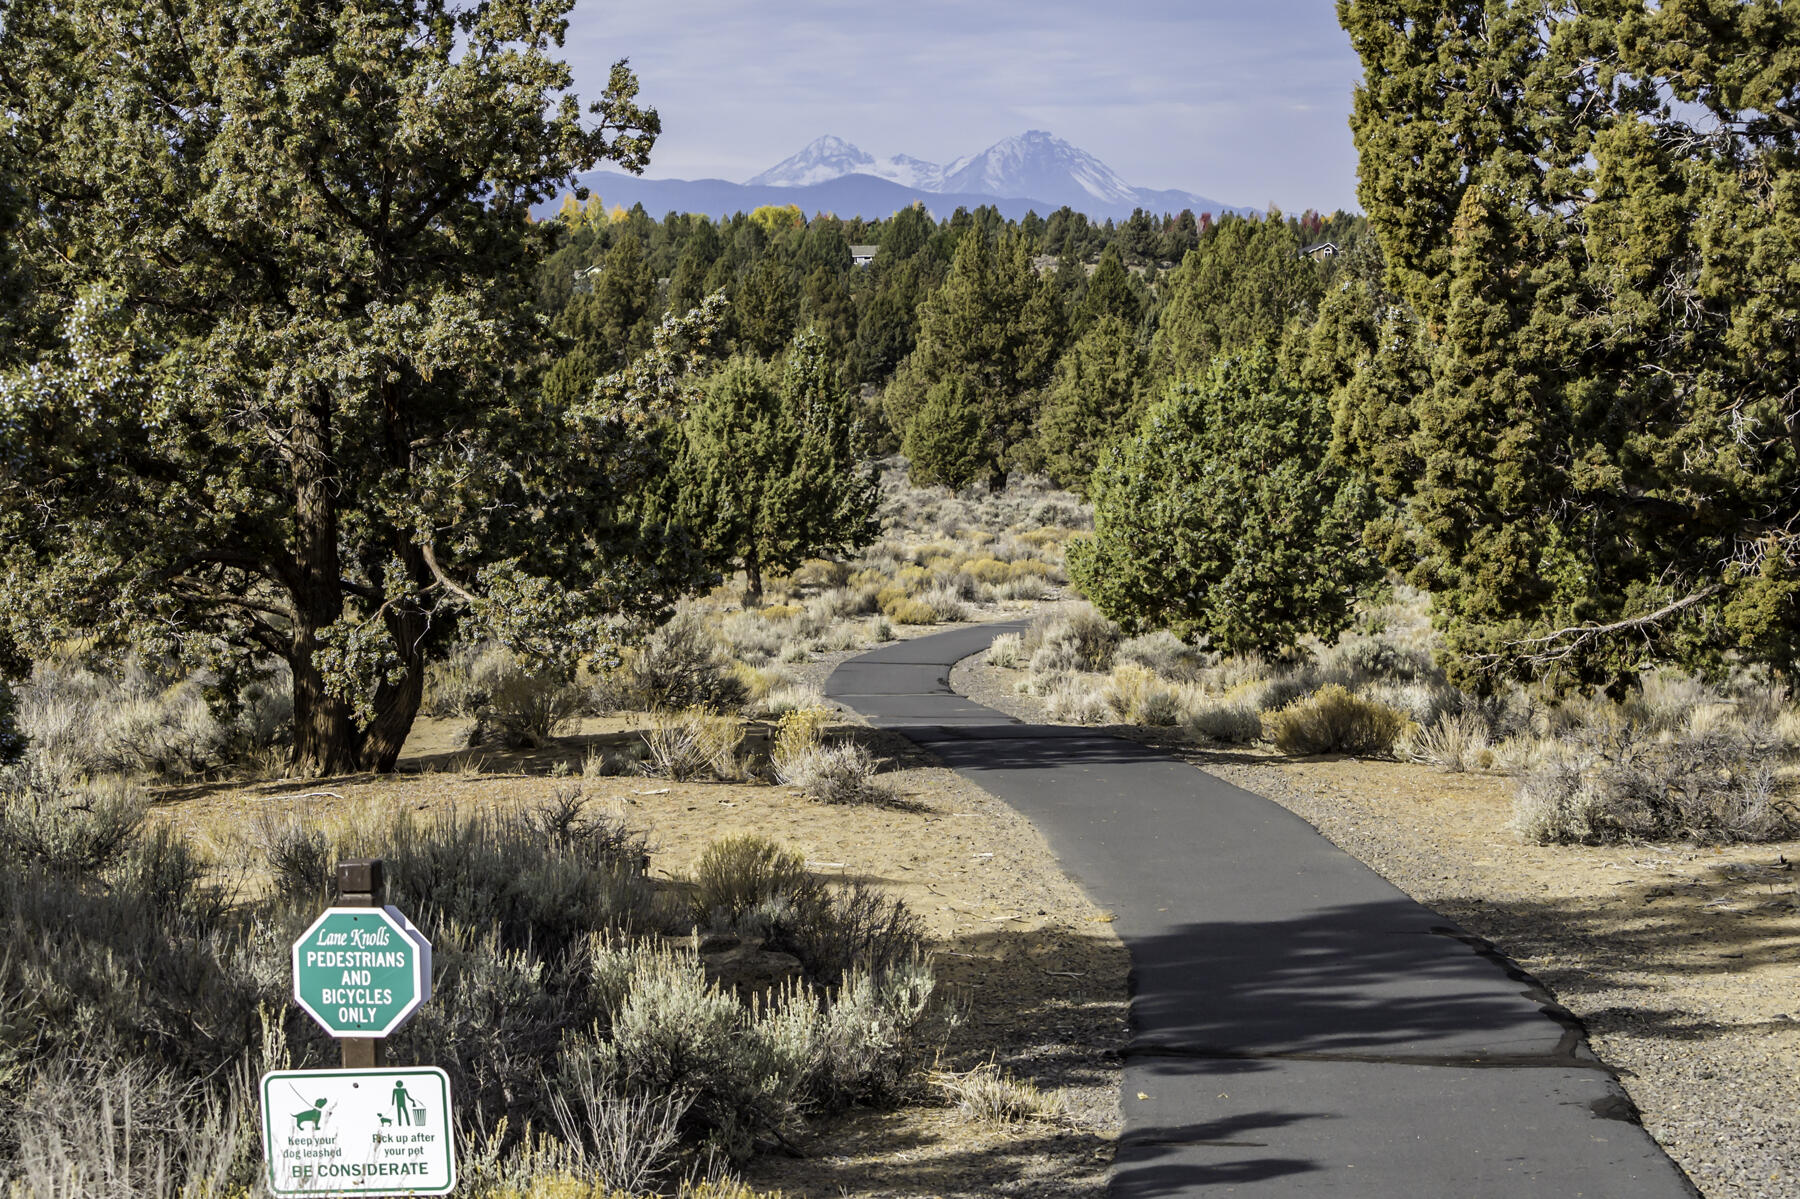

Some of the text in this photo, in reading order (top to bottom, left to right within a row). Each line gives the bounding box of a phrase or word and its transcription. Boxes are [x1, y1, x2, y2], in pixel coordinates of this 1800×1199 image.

[316, 926, 390, 949] Lane Knolls
[307, 951, 405, 968] PEDESTRIANS
[341, 970, 371, 986] AND
[322, 988, 392, 1005] BICYCLES
[338, 1007, 377, 1023] ONLY
[288, 1136, 336, 1147] Keep your
[372, 1132, 435, 1145] Pck up after
[283, 1148, 301, 1160] dog
[384, 1145, 424, 1158] your pet
[292, 1165, 313, 1178] BE
